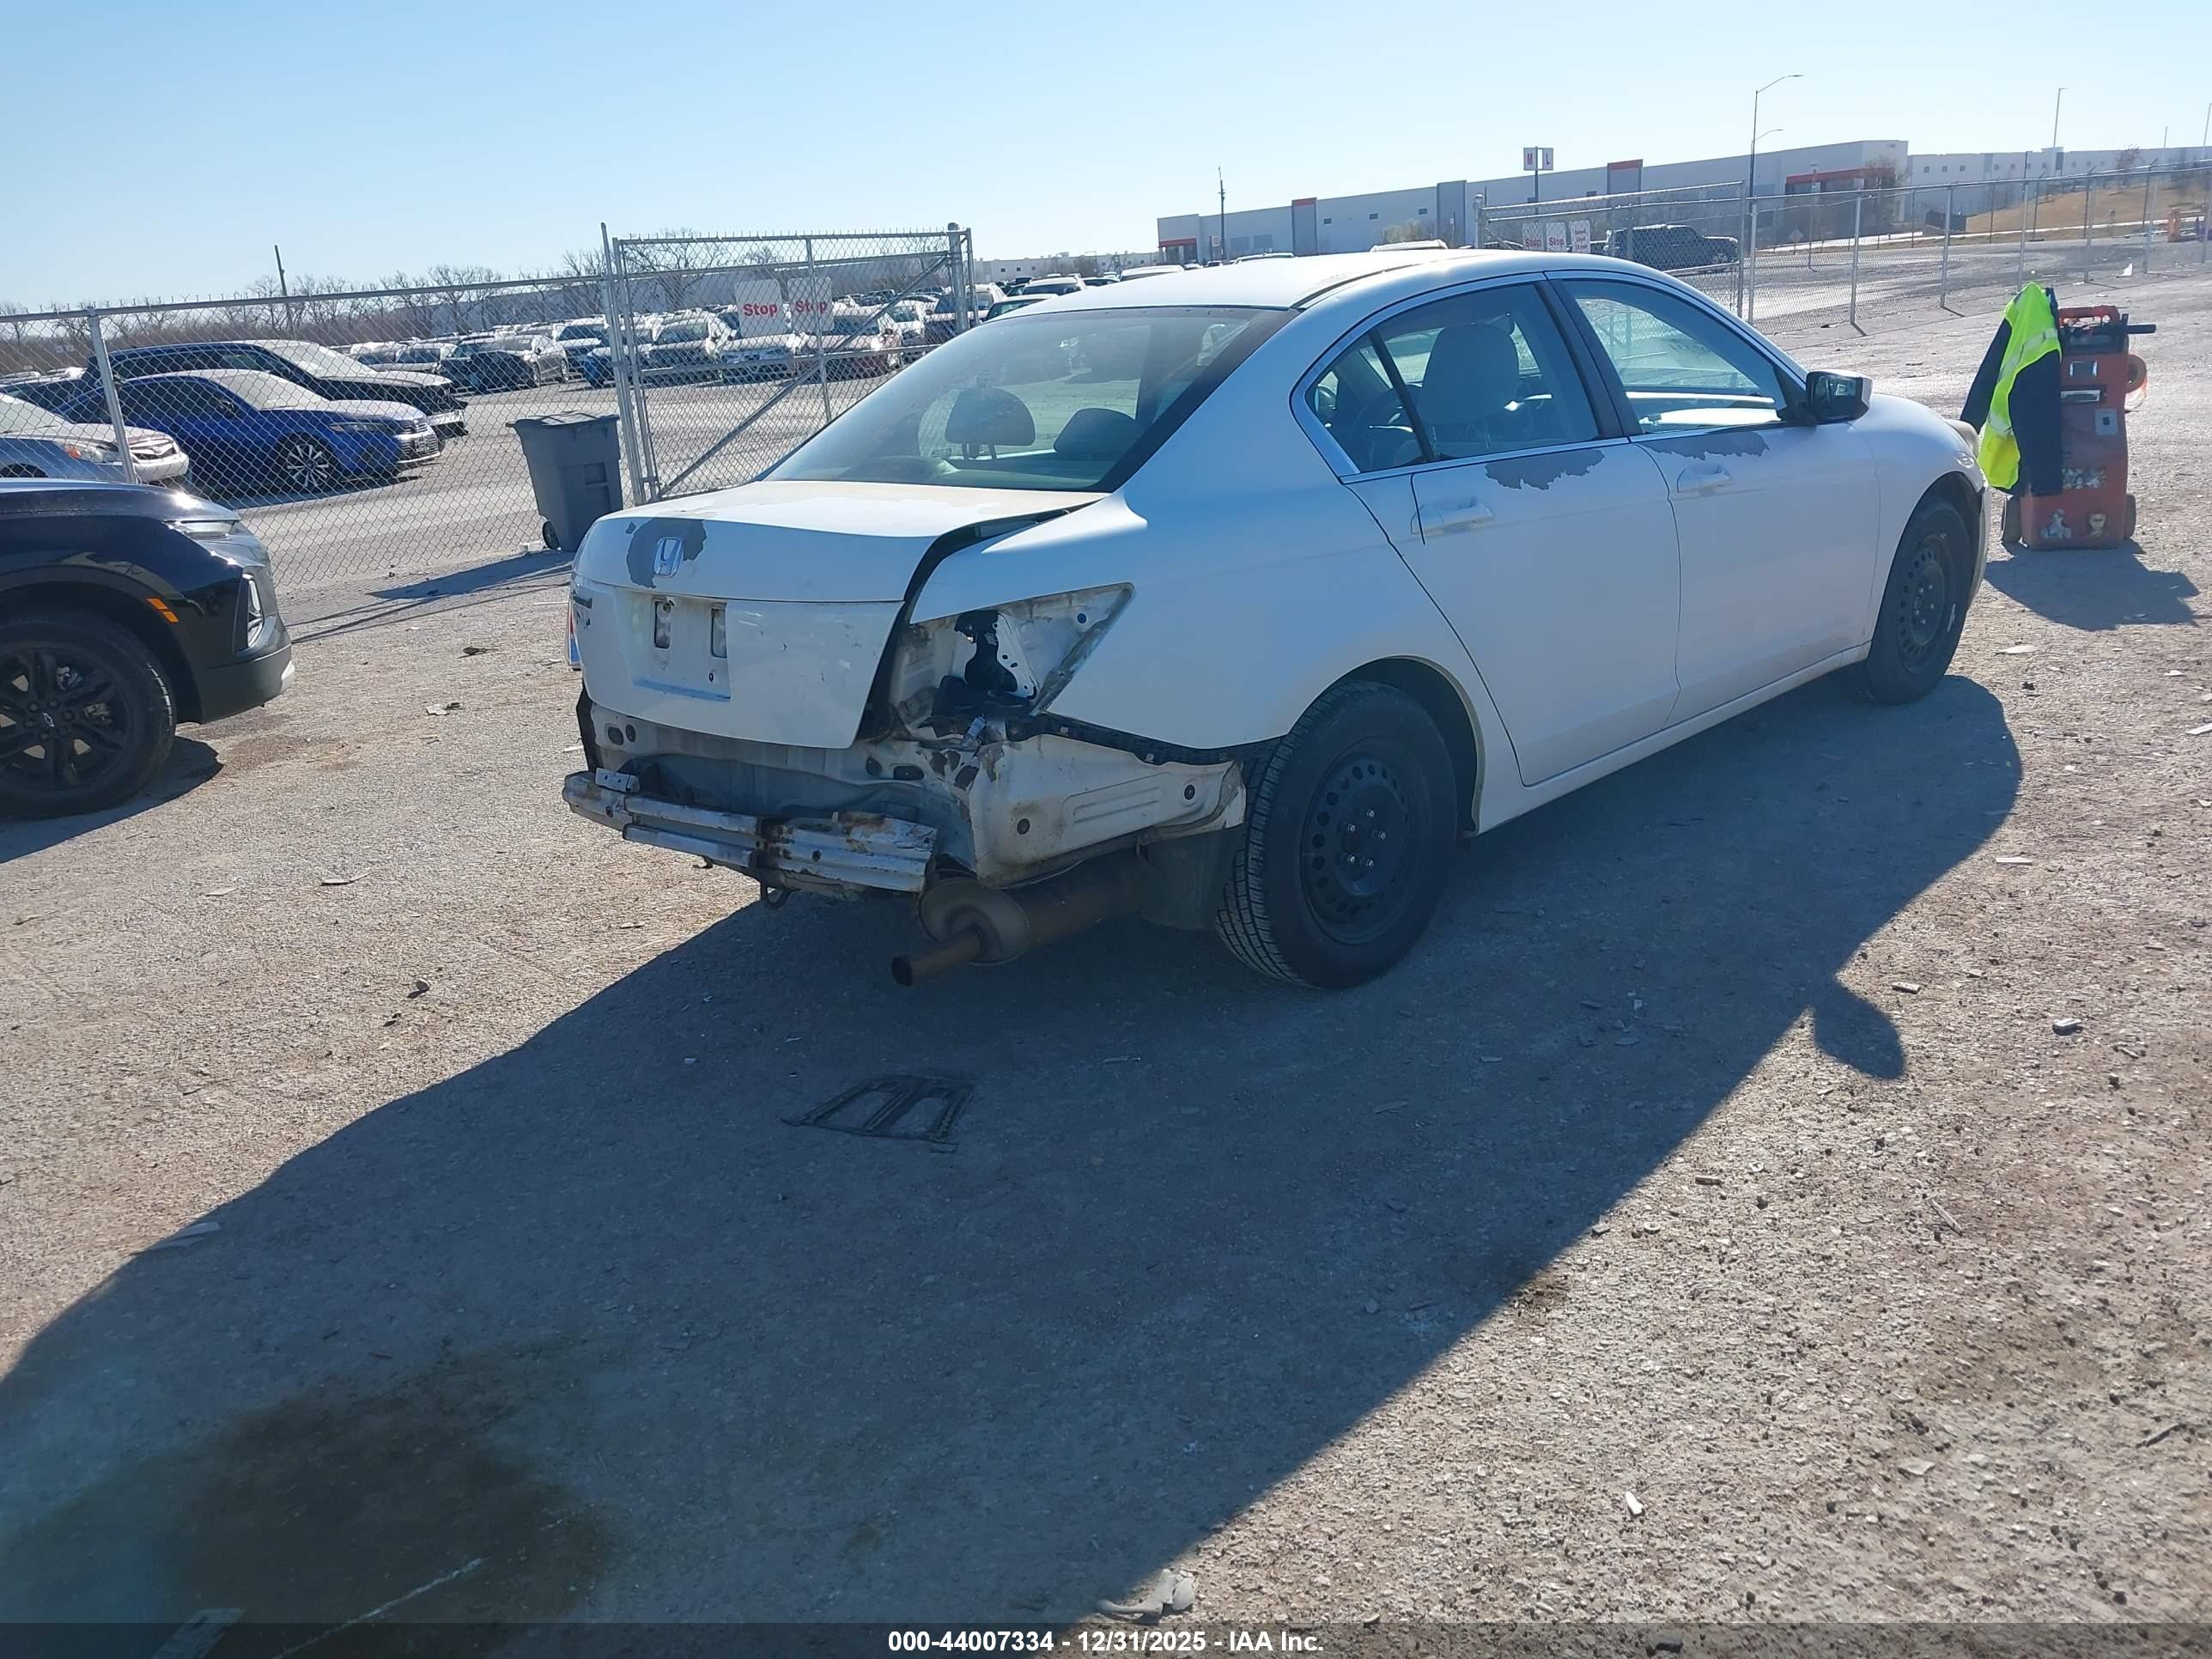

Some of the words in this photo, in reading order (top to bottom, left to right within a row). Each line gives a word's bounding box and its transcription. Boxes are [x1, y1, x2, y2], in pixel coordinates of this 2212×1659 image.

[1549, 237, 1564, 246] Stop
[743, 303, 778, 317] Stop
[795, 301, 827, 313] Stp
